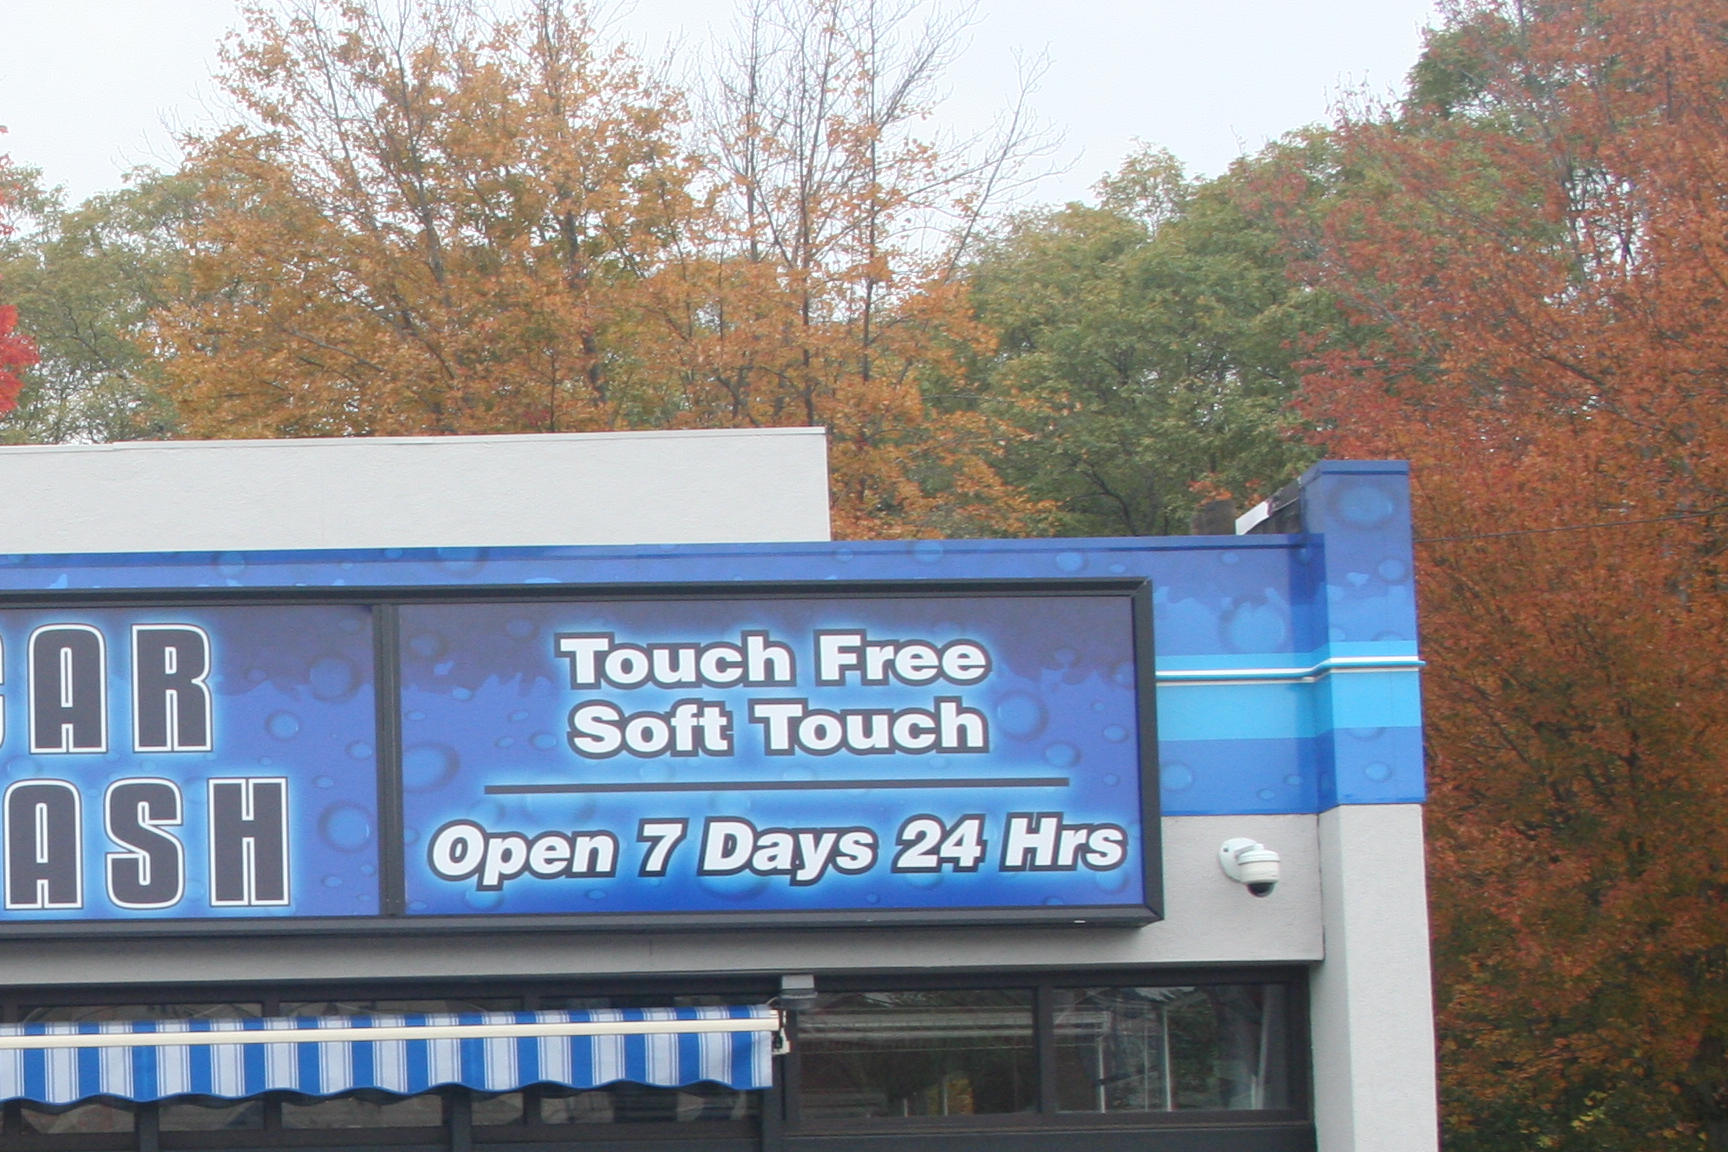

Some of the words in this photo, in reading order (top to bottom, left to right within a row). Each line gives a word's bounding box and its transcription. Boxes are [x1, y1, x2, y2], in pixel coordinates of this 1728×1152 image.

[556, 632, 794, 688] Touch
[816, 629, 991, 683] Free
[568, 700, 733, 758] Soft
[751, 697, 989, 752] Touch
[429, 819, 620, 890] Open
[637, 817, 688, 877] 7
[698, 816, 876, 886] Days
[892, 814, 987, 873] 24
[1004, 811, 1128, 872] Hrs
